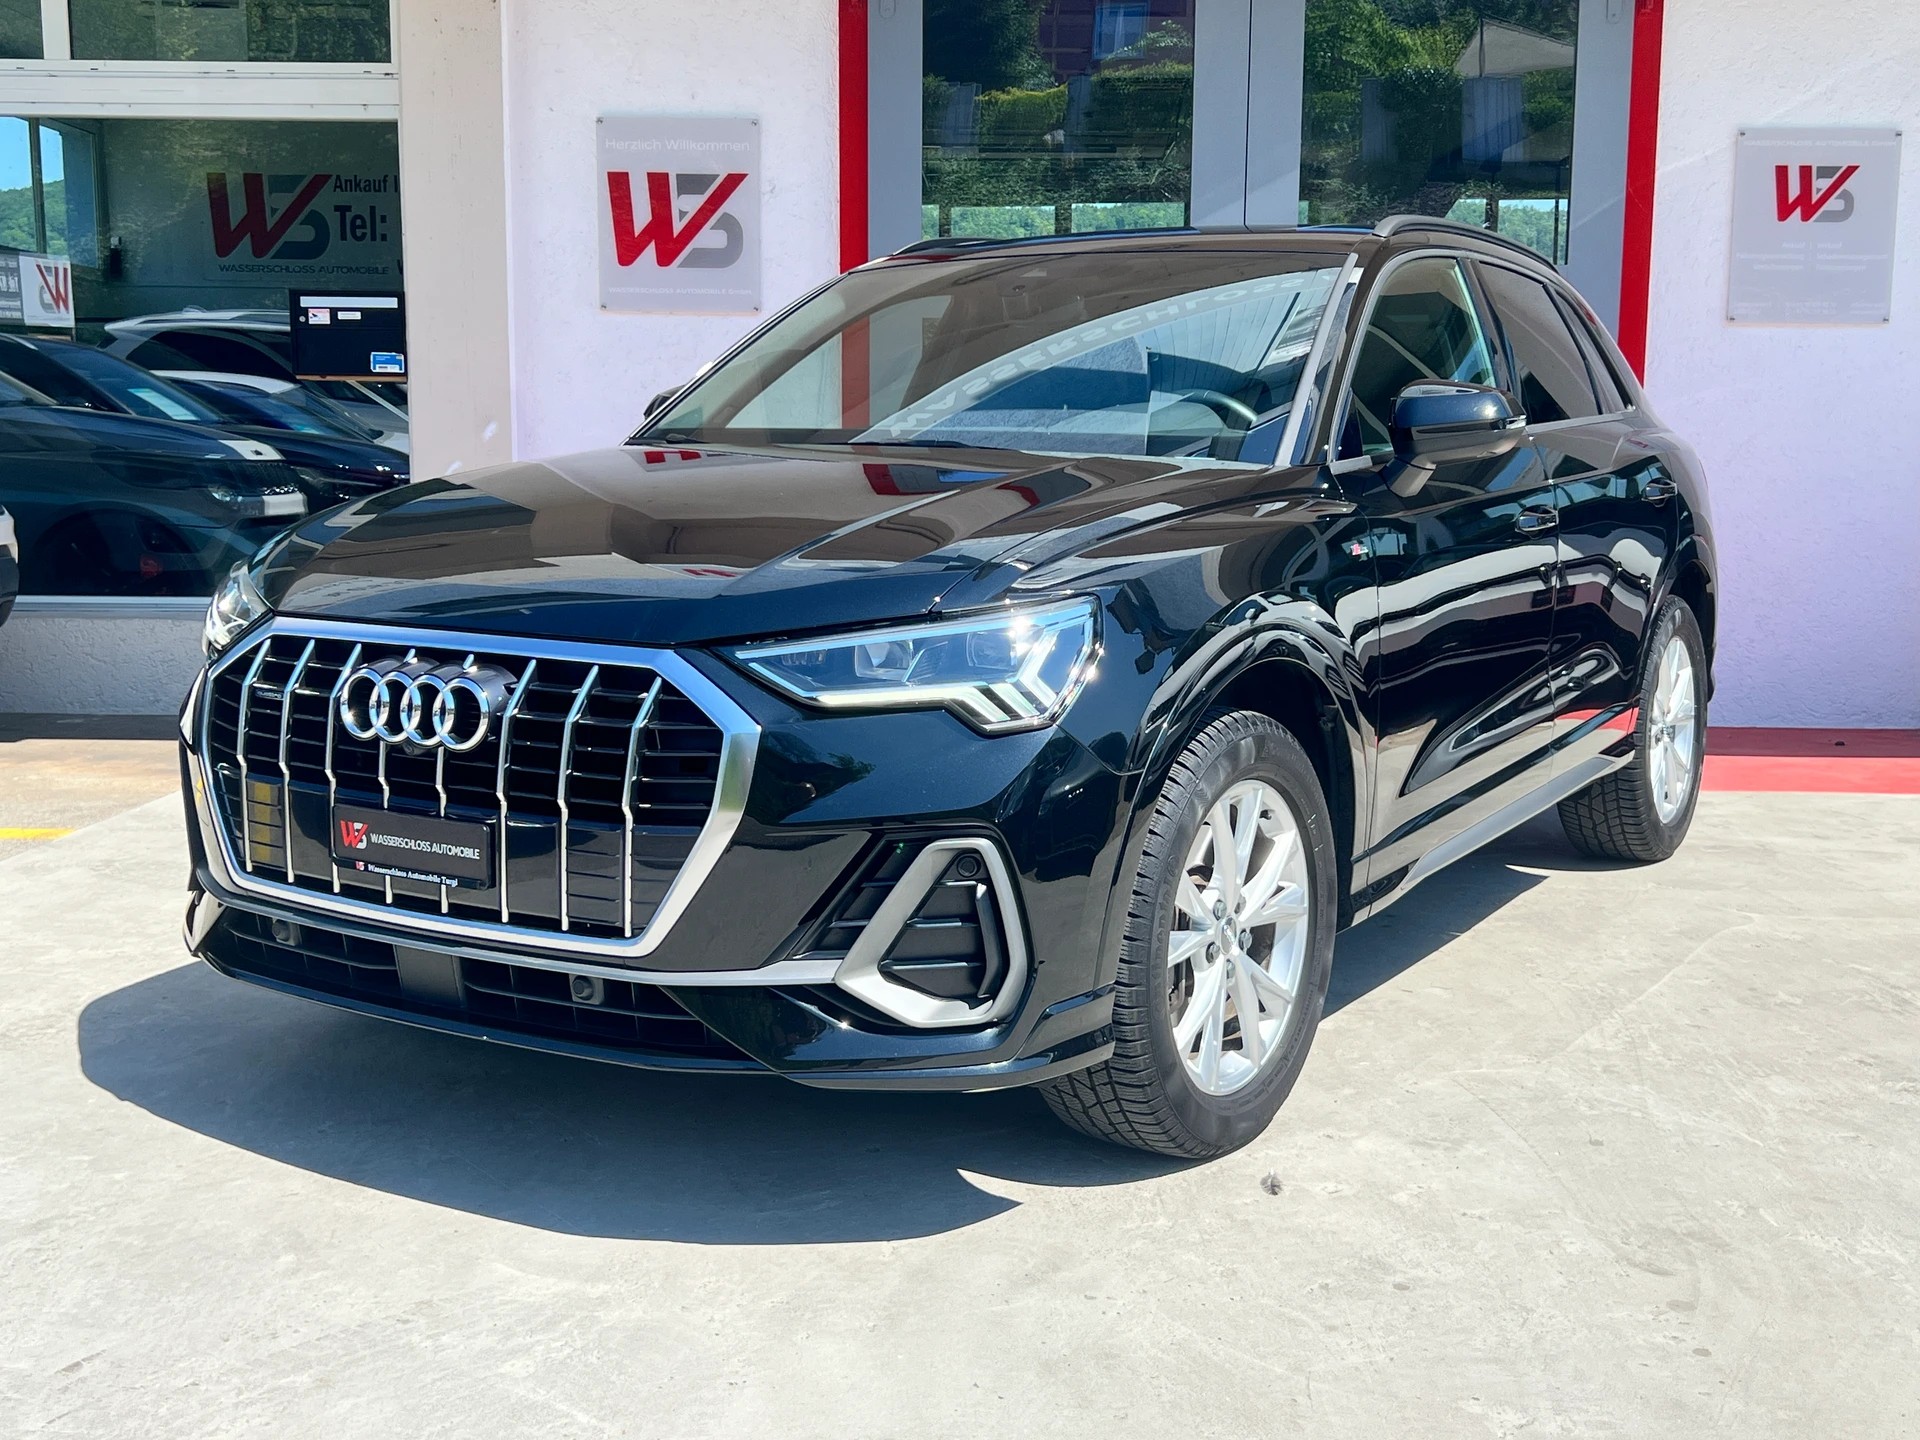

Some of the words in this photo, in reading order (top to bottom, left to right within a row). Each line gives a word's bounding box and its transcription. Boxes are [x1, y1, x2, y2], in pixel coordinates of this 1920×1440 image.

[605, 138, 662, 151] Herzlich
[665, 139, 750, 151] Willkommen
[333, 174, 389, 193] Ankauf
[333, 204, 388, 242] Tel:
[218, 263, 316, 274] WASSERSCHLOSS
[318, 265, 389, 275] AUTOMOBILE
[370, 832, 432, 853] WASSERSCHLOSS
[431, 842, 481, 860] AUTOMOBILE
